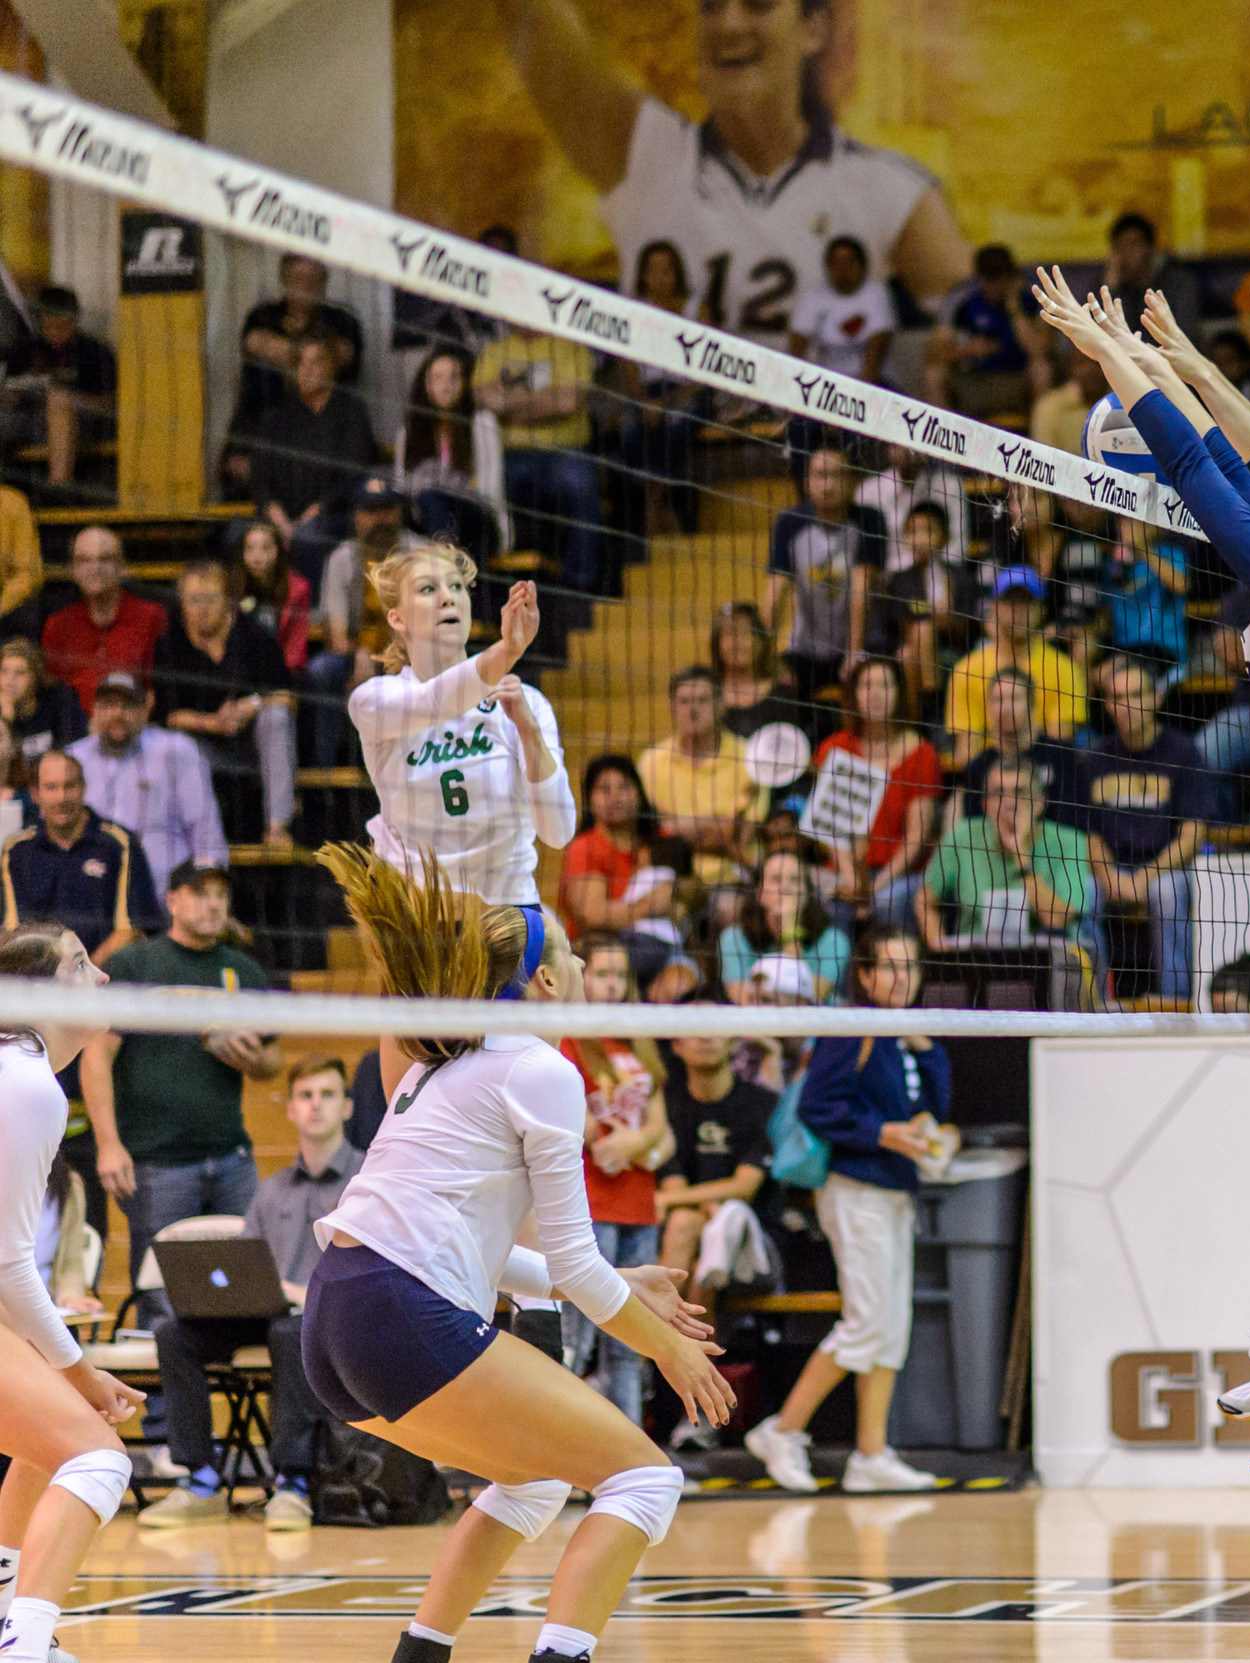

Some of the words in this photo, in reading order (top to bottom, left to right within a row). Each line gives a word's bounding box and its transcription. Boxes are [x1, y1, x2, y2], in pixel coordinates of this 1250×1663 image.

[704, 252, 797, 333] 12
[407, 722, 493, 767] Irish
[440, 769, 470, 817] 6
